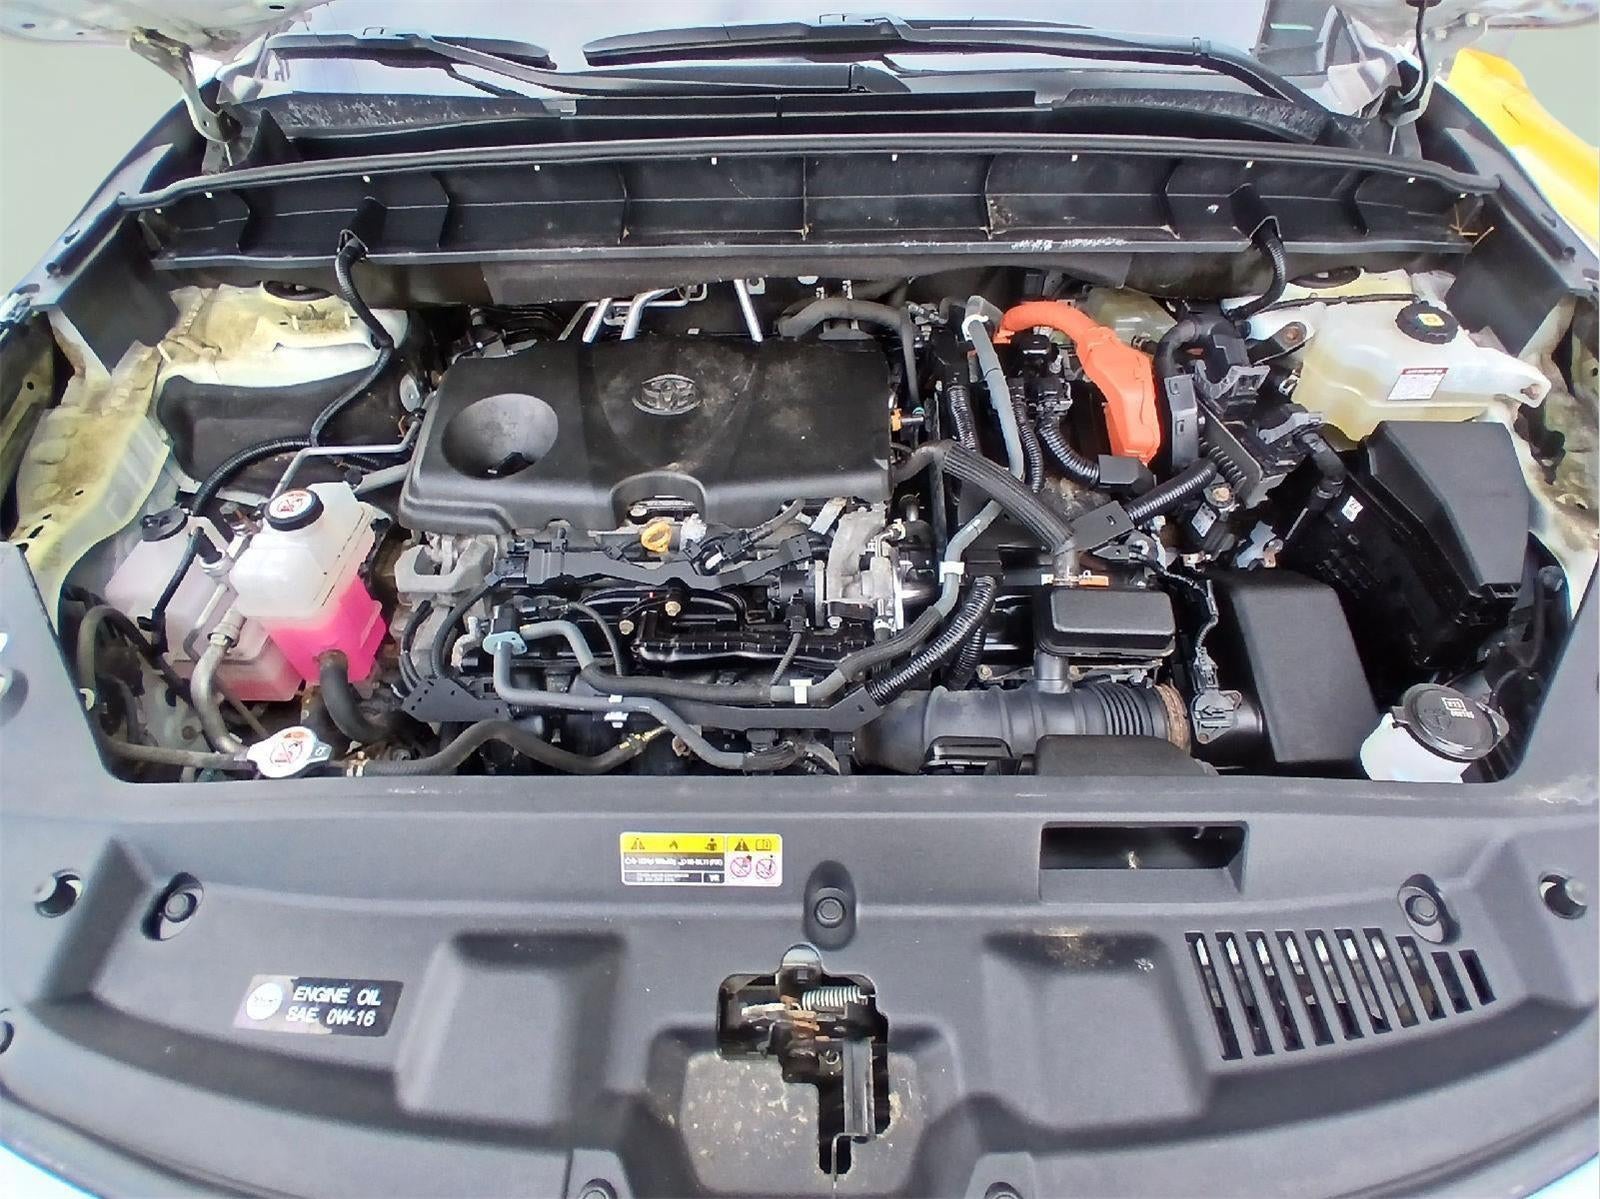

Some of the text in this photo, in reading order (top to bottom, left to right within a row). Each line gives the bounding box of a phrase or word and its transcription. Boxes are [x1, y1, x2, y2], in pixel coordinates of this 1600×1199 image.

[292, 986, 350, 1004] ENGINE
[356, 988, 382, 1006] OIL
[285, 1005, 376, 1027] SAE 0W-16
